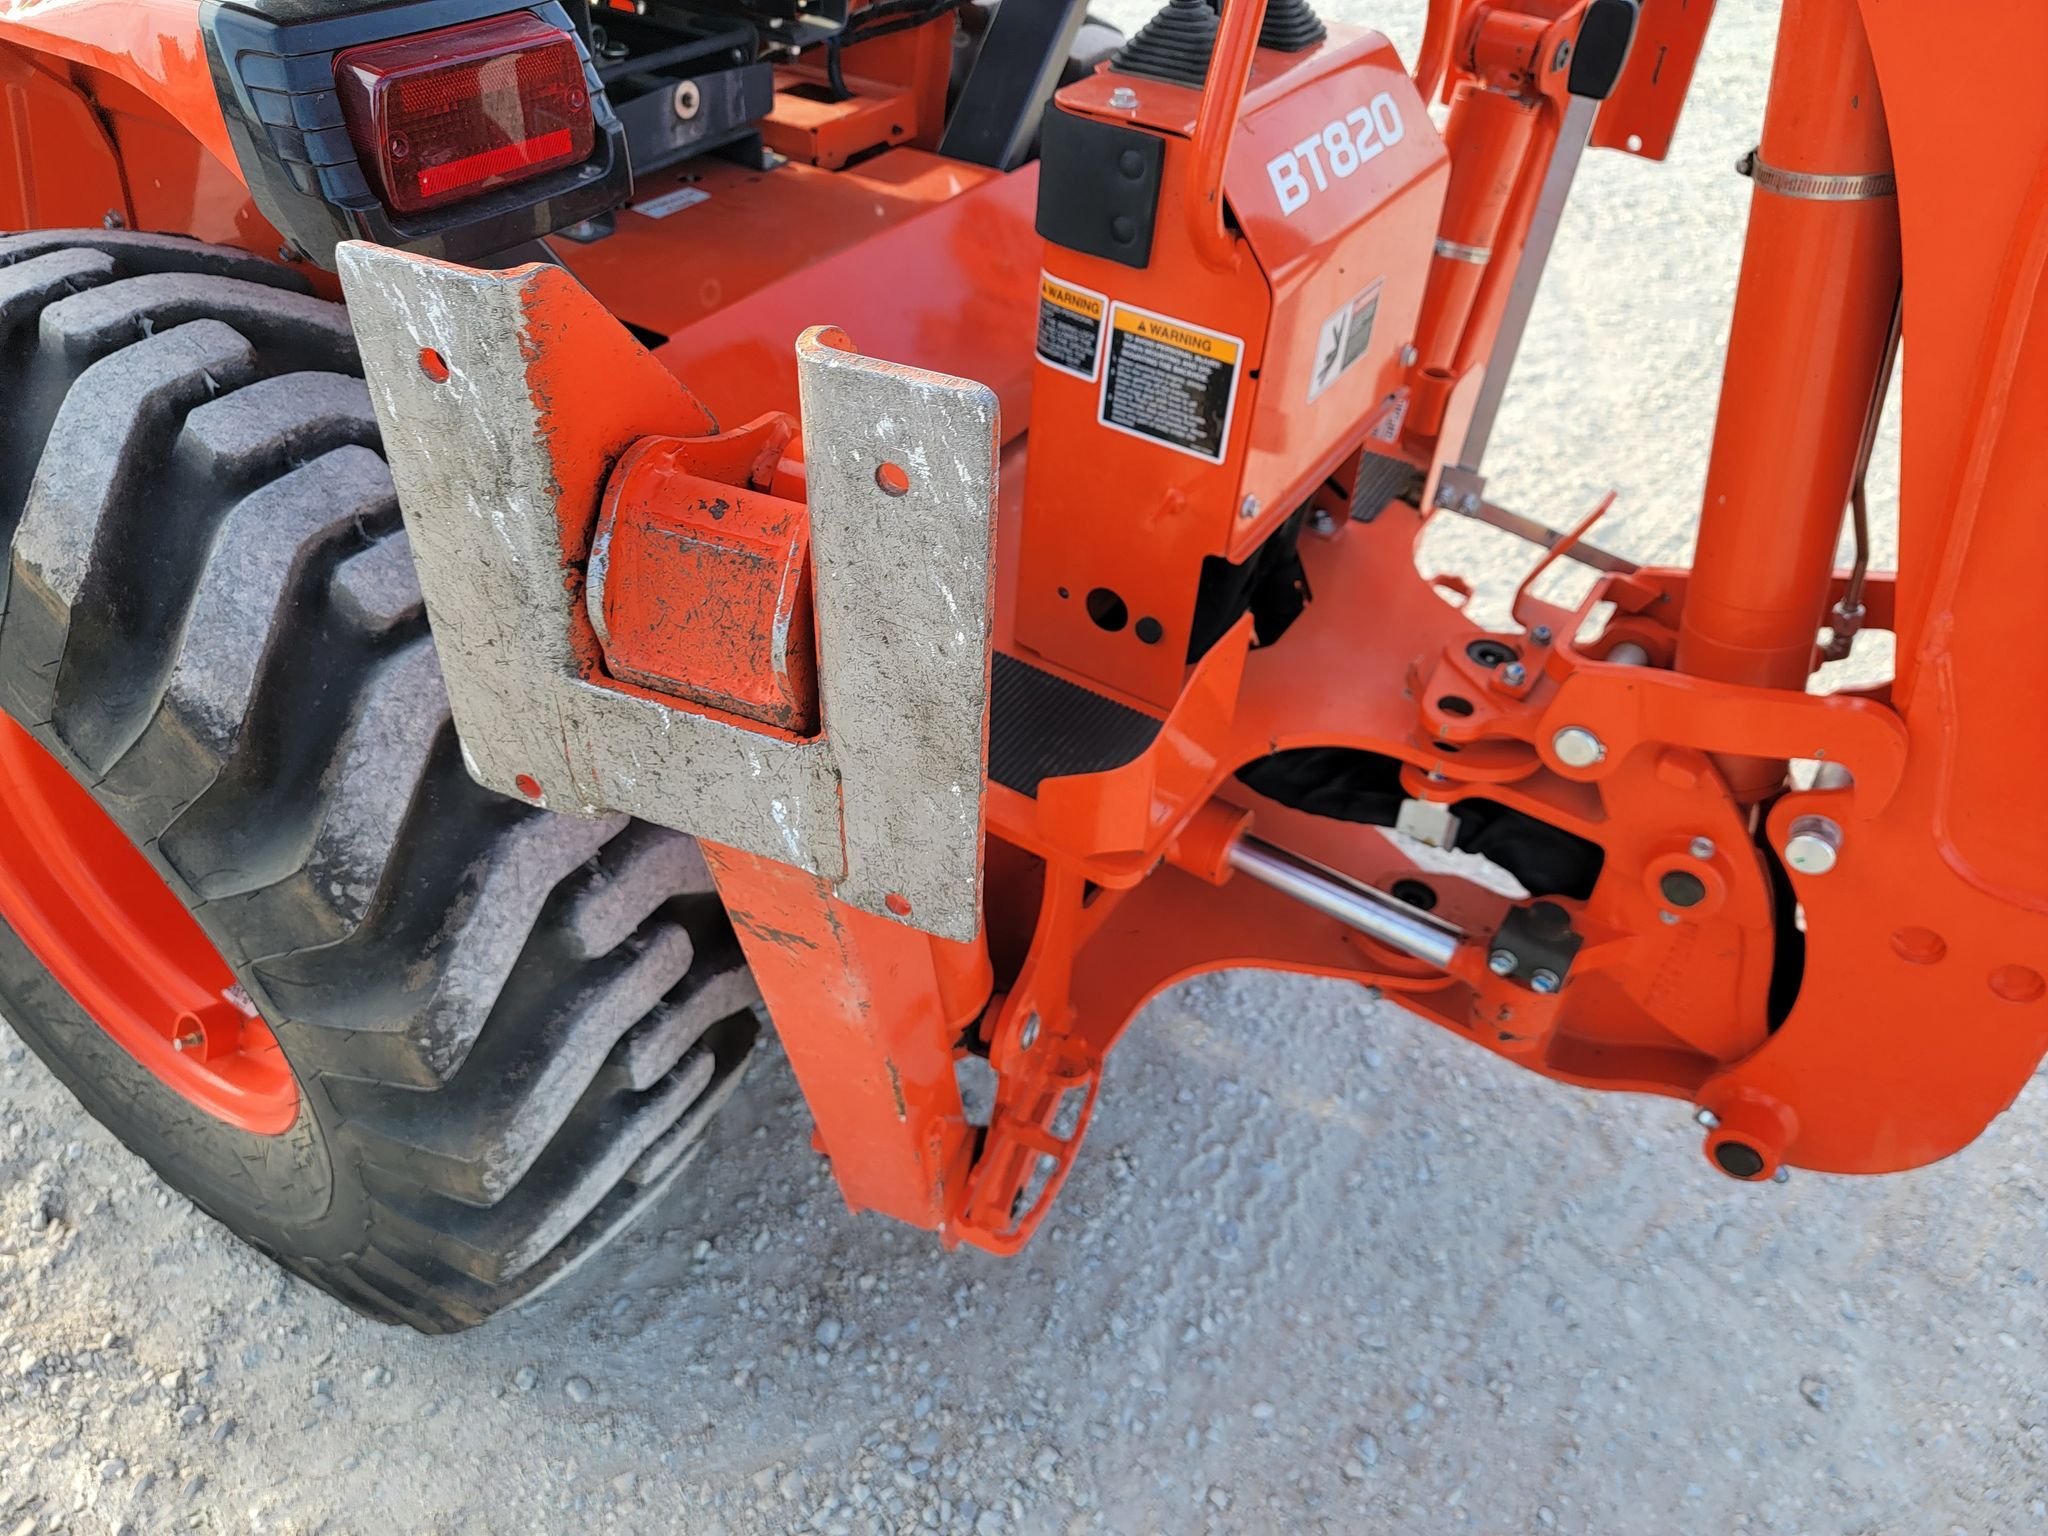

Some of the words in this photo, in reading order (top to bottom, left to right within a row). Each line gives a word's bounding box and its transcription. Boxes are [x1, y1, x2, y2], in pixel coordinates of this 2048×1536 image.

[1266, 91, 1405, 216] BT820
[1048, 287, 1099, 314] WARNING
[1150, 323, 1211, 352] WARNING
